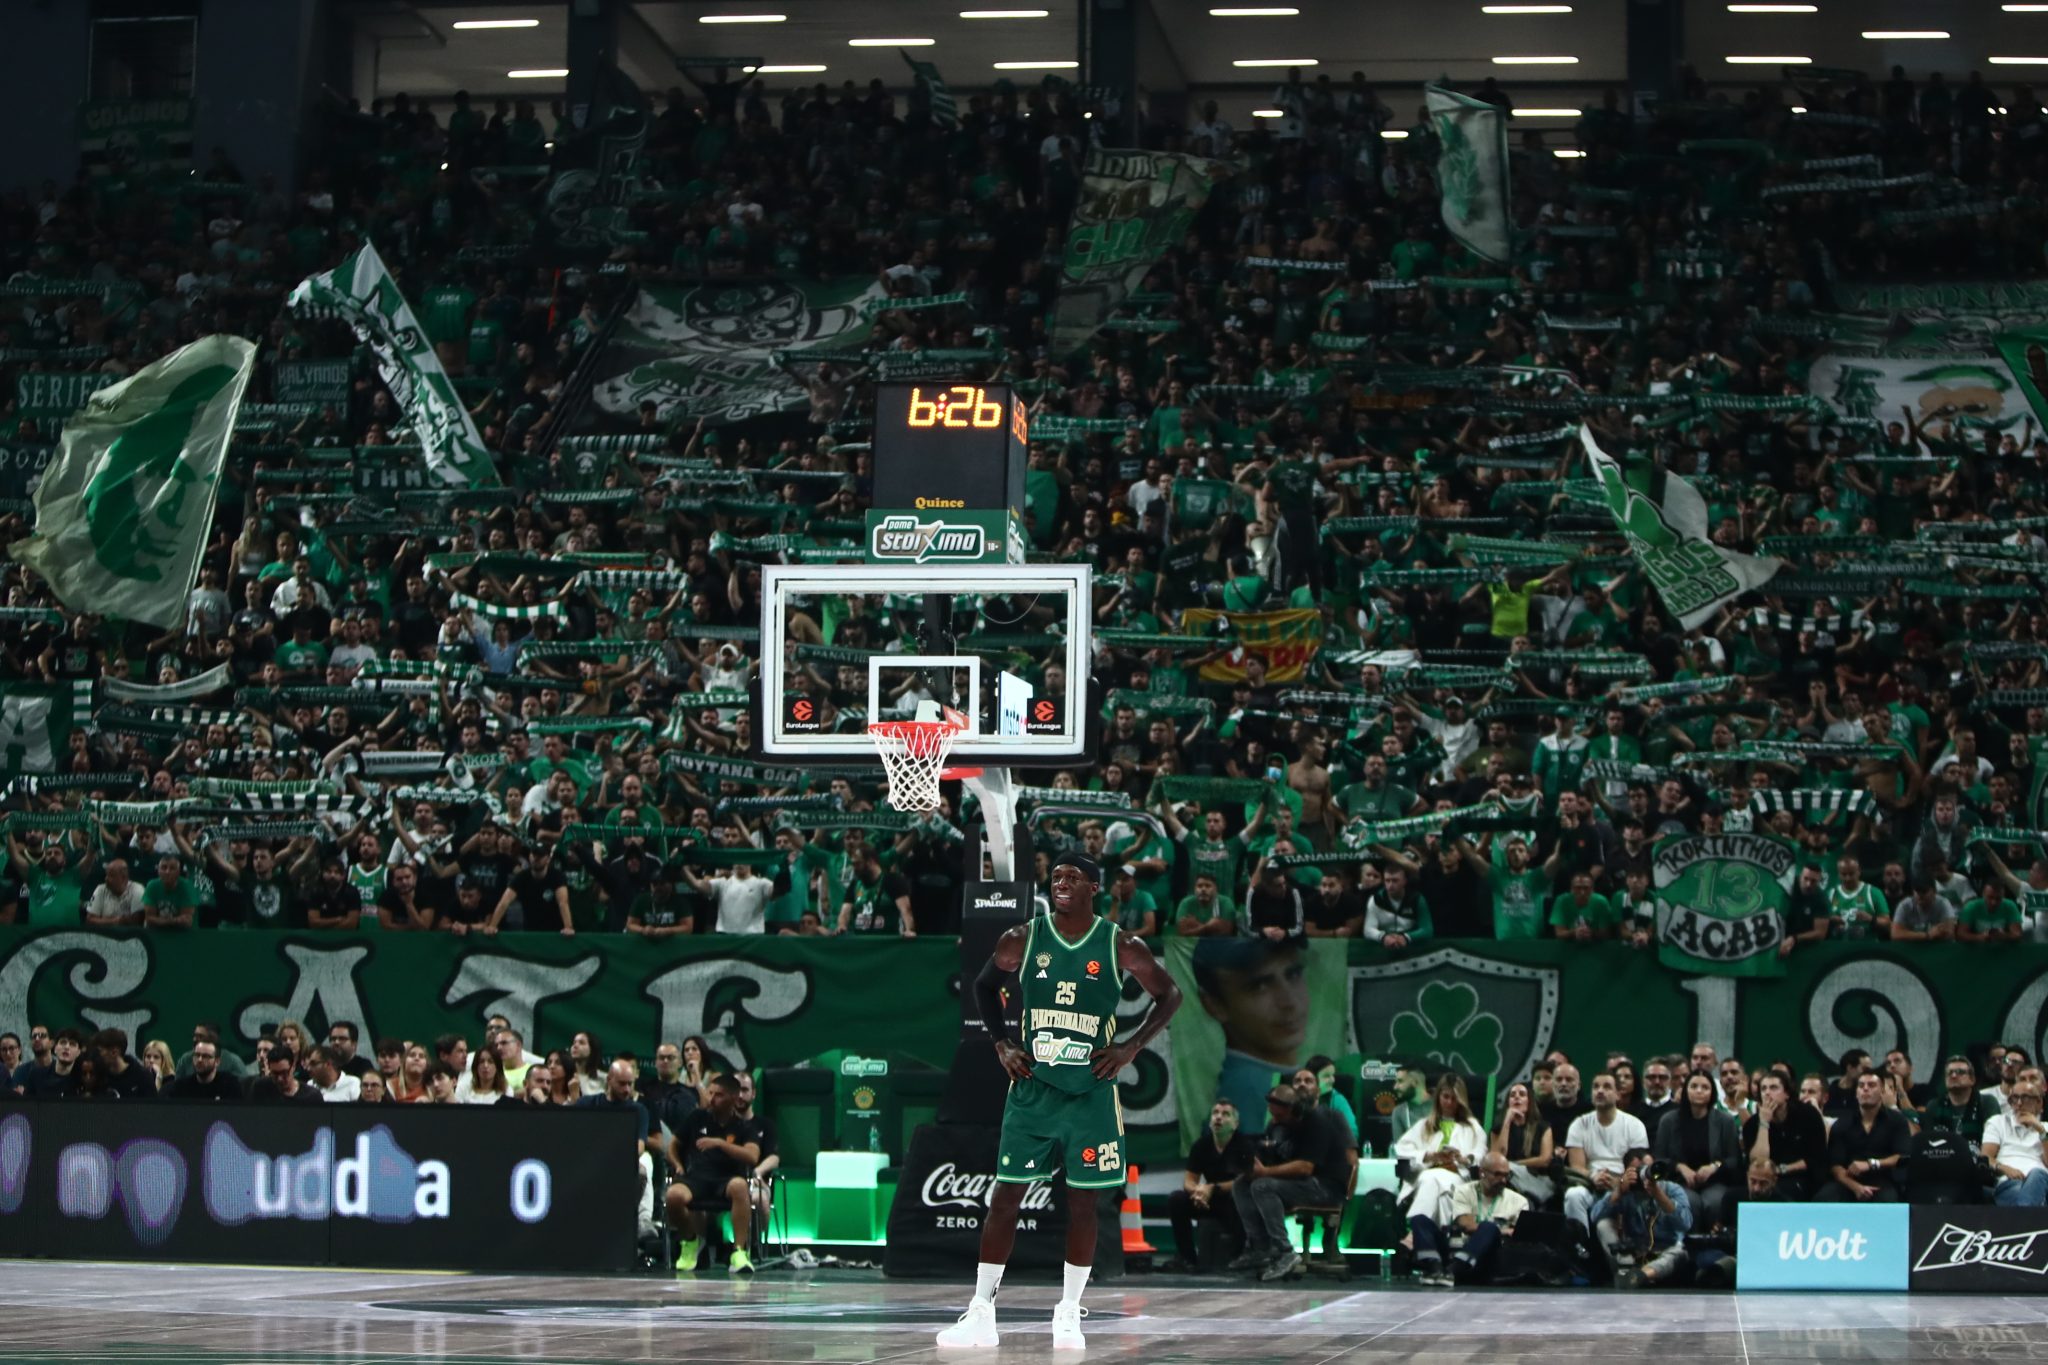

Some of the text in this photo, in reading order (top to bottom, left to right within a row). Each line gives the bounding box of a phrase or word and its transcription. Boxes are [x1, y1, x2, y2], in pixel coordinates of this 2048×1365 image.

[915, 497, 965, 510] Quince
[786, 722, 820, 731] EuroLeague
[1027, 723, 1062, 732] EuroLeague
[974, 898, 1017, 909] SPALDING
[1690, 861, 1763, 919] 13
[1670, 910, 1777, 958] ACAB
[1055, 981, 1077, 1006] 25
[1030, 1008, 1100, 1038] PANATHINAIKOS
[1098, 1141, 1121, 1172] 25
[935, 1216, 978, 1229] ZERO
[1779, 1228, 1868, 1262] Wolt
[1943, 1229, 2034, 1264] Bud
